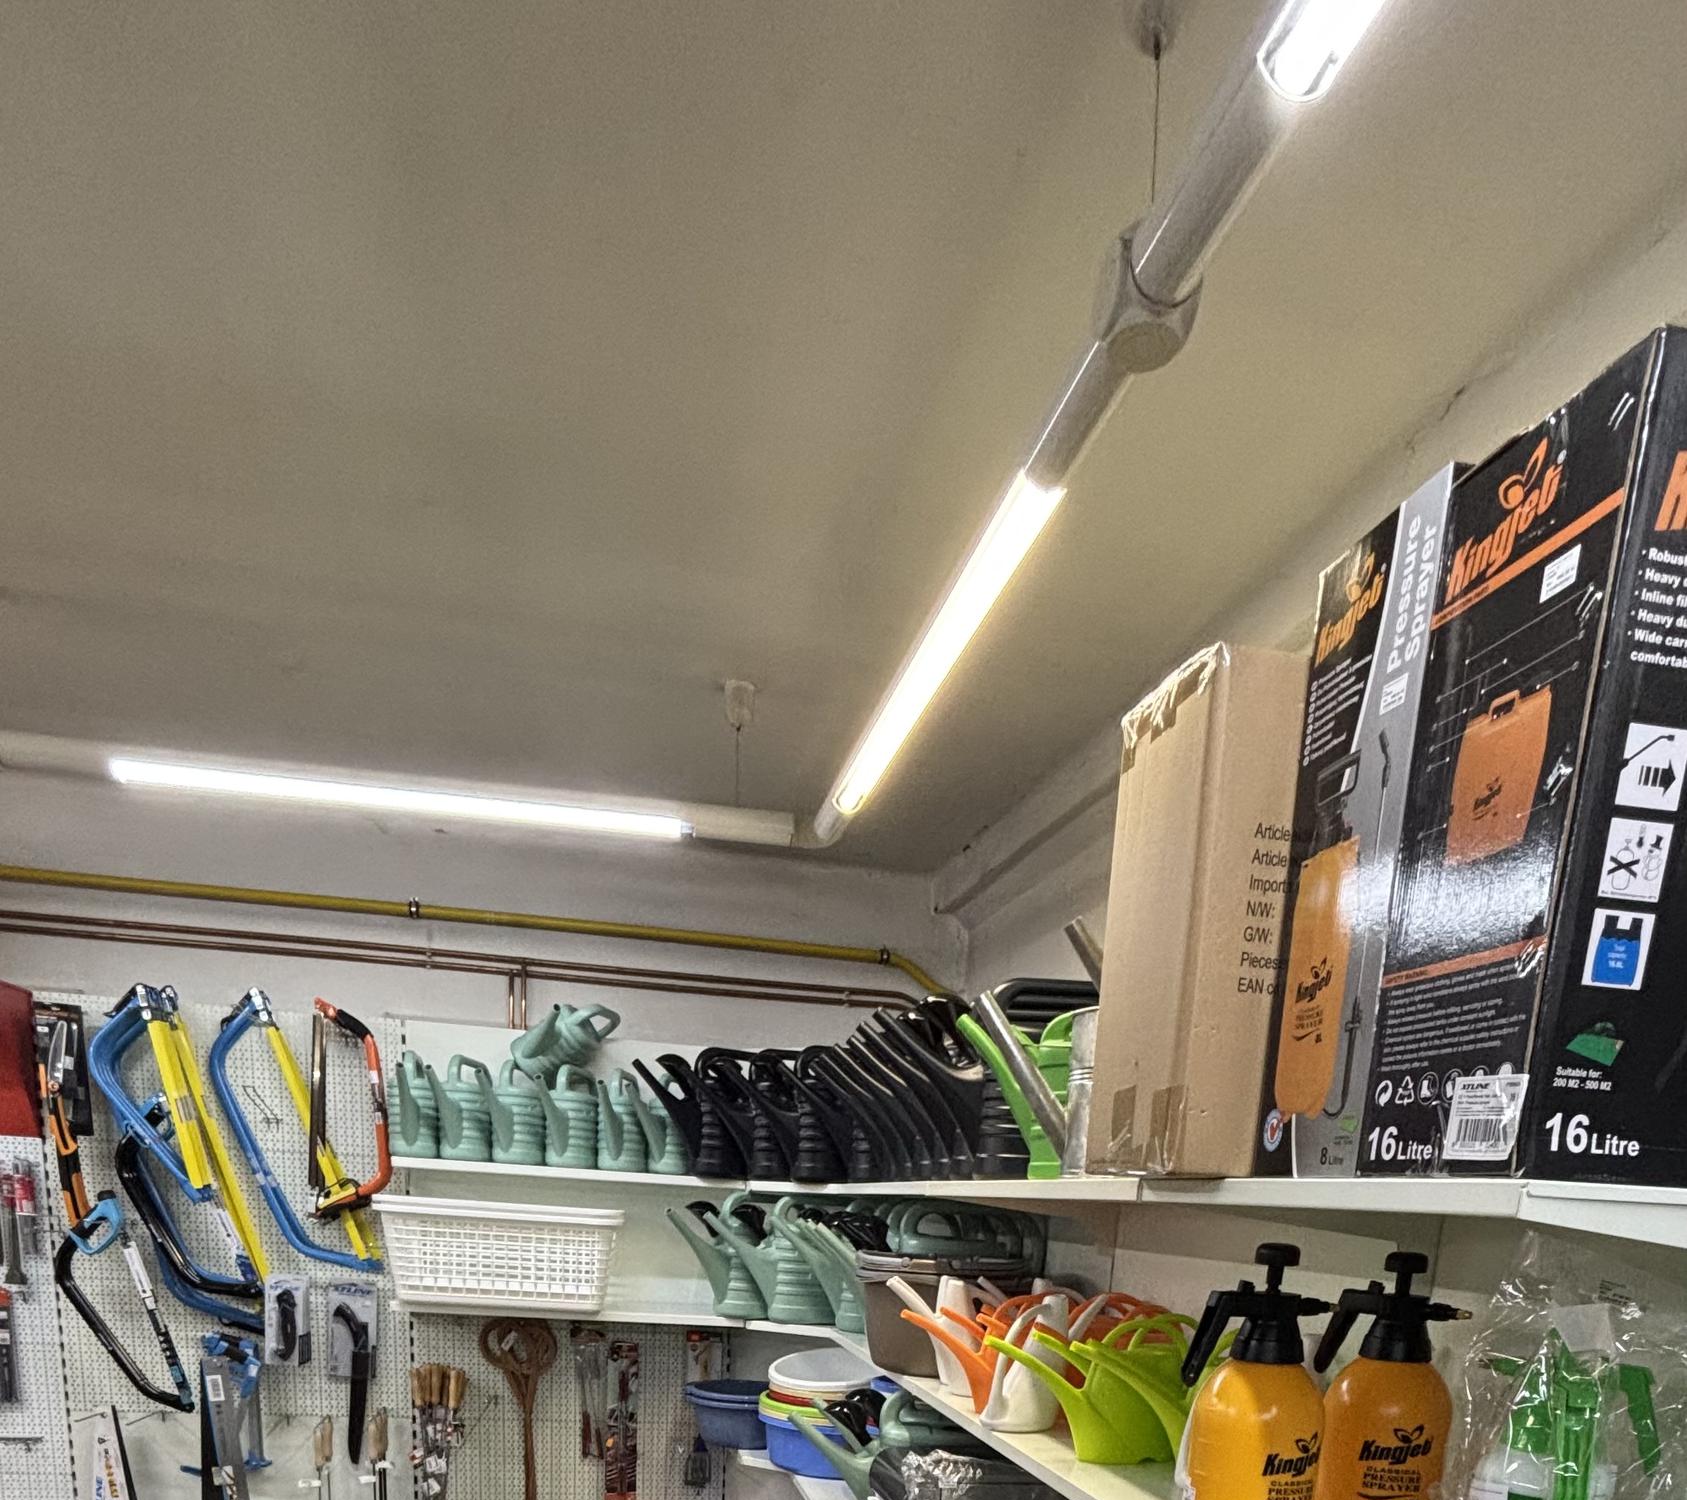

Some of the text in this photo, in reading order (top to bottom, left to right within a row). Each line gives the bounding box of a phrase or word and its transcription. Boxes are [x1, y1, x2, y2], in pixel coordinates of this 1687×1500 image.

[1644, 568, 1681, 589] Heavy
[1386, 515, 1421, 674] Pressure
[1405, 526, 1438, 663] Sprayer
[1641, 588, 1674, 605] Inline
[1637, 608, 1674, 629] Heavy
[1634, 628, 1663, 644] Wide
[1255, 822, 1291, 842] Article
[1252, 849, 1287, 867] Article
[1246, 900, 1275, 919] N/W:
[1243, 926, 1273, 944] G/W:
[1237, 977, 1263, 994] EAN
[1556, 1066, 1603, 1079] Suitable for:
[1368, 1126, 1398, 1161] 16
[1397, 1140, 1433, 1161] Litre
[1545, 1112, 1640, 1157] 16 Litre
[1320, 1147, 1328, 1165] 8
[1362, 1481, 1420, 1493] SPRAYER
[1363, 1473, 1421, 1484] PRESSURE
